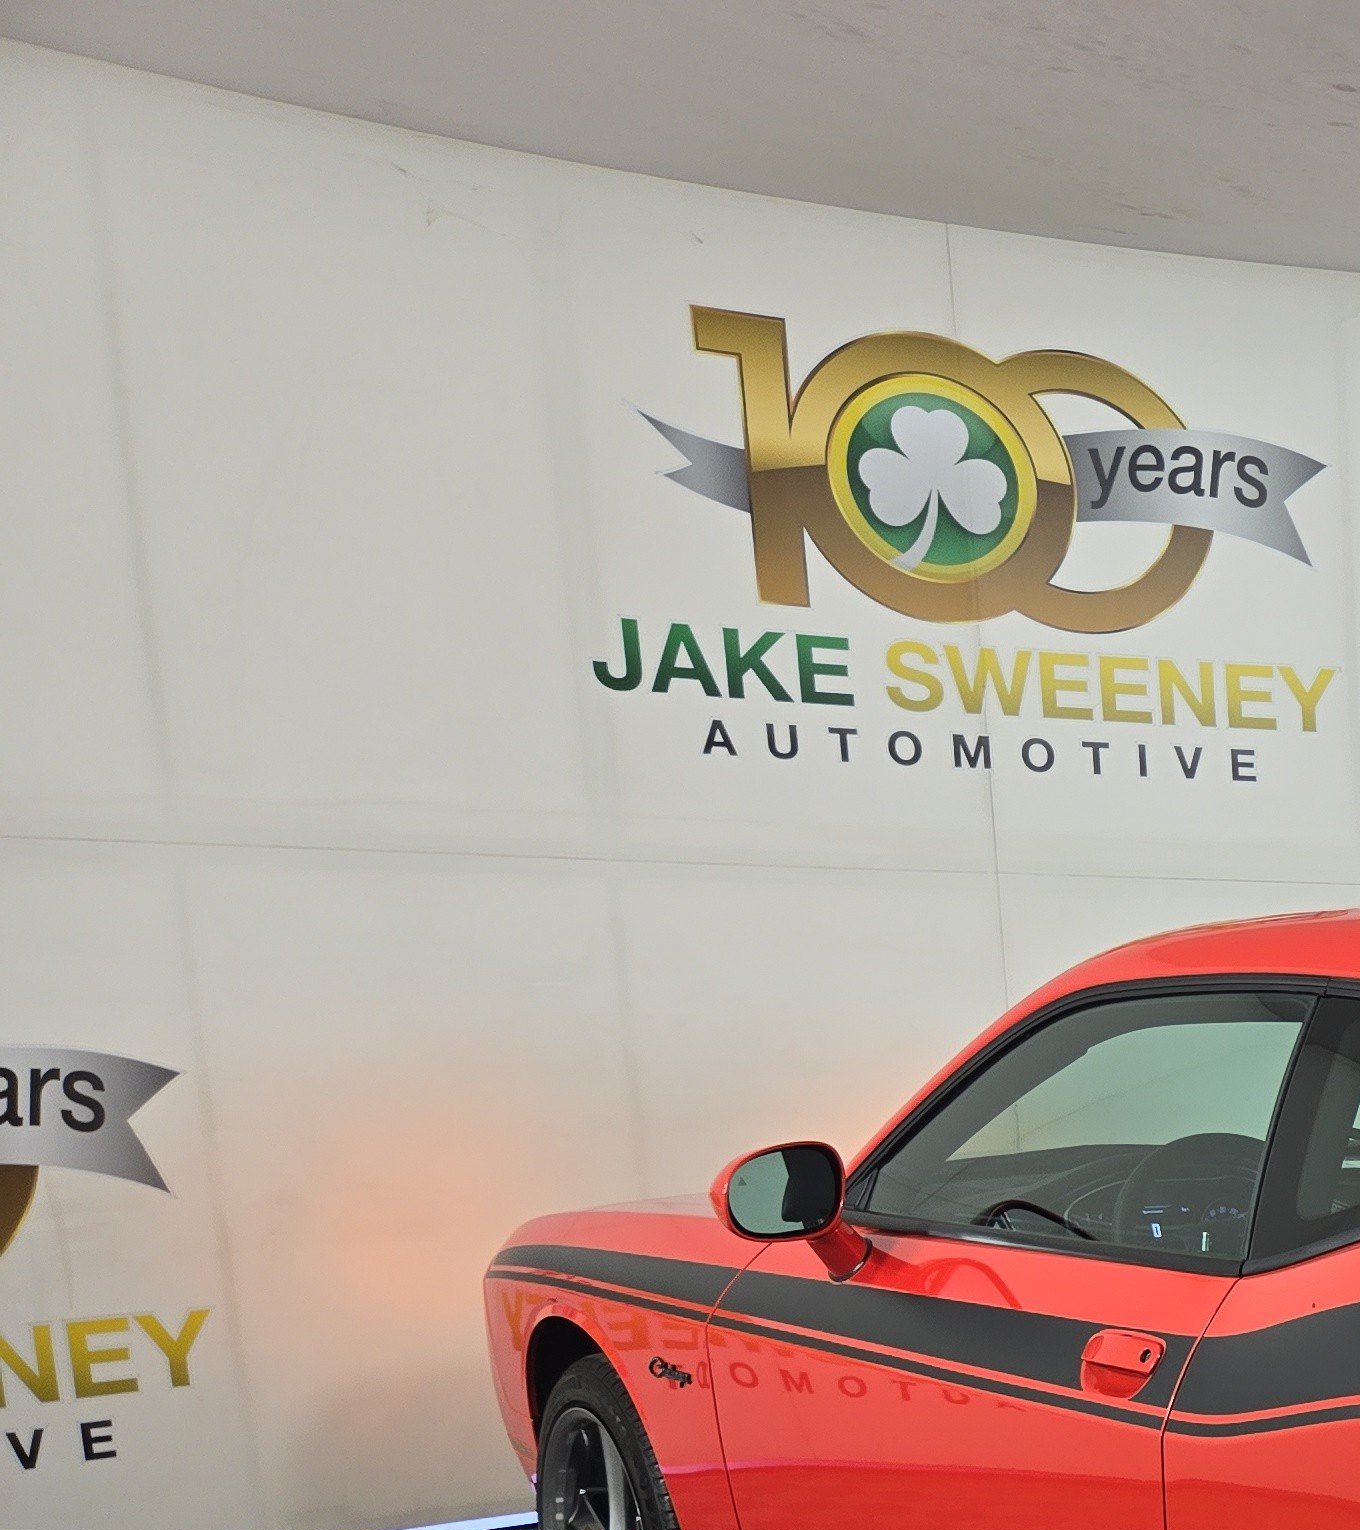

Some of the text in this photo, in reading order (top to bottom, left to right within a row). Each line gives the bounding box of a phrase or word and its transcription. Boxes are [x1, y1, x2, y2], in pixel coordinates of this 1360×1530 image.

[689, 304, 1214, 635] 100
[1086, 441, 1270, 509] years
[591, 617, 1337, 733] JAKE SWEENEY
[702, 718, 1259, 783] AUTOMOTIVE
